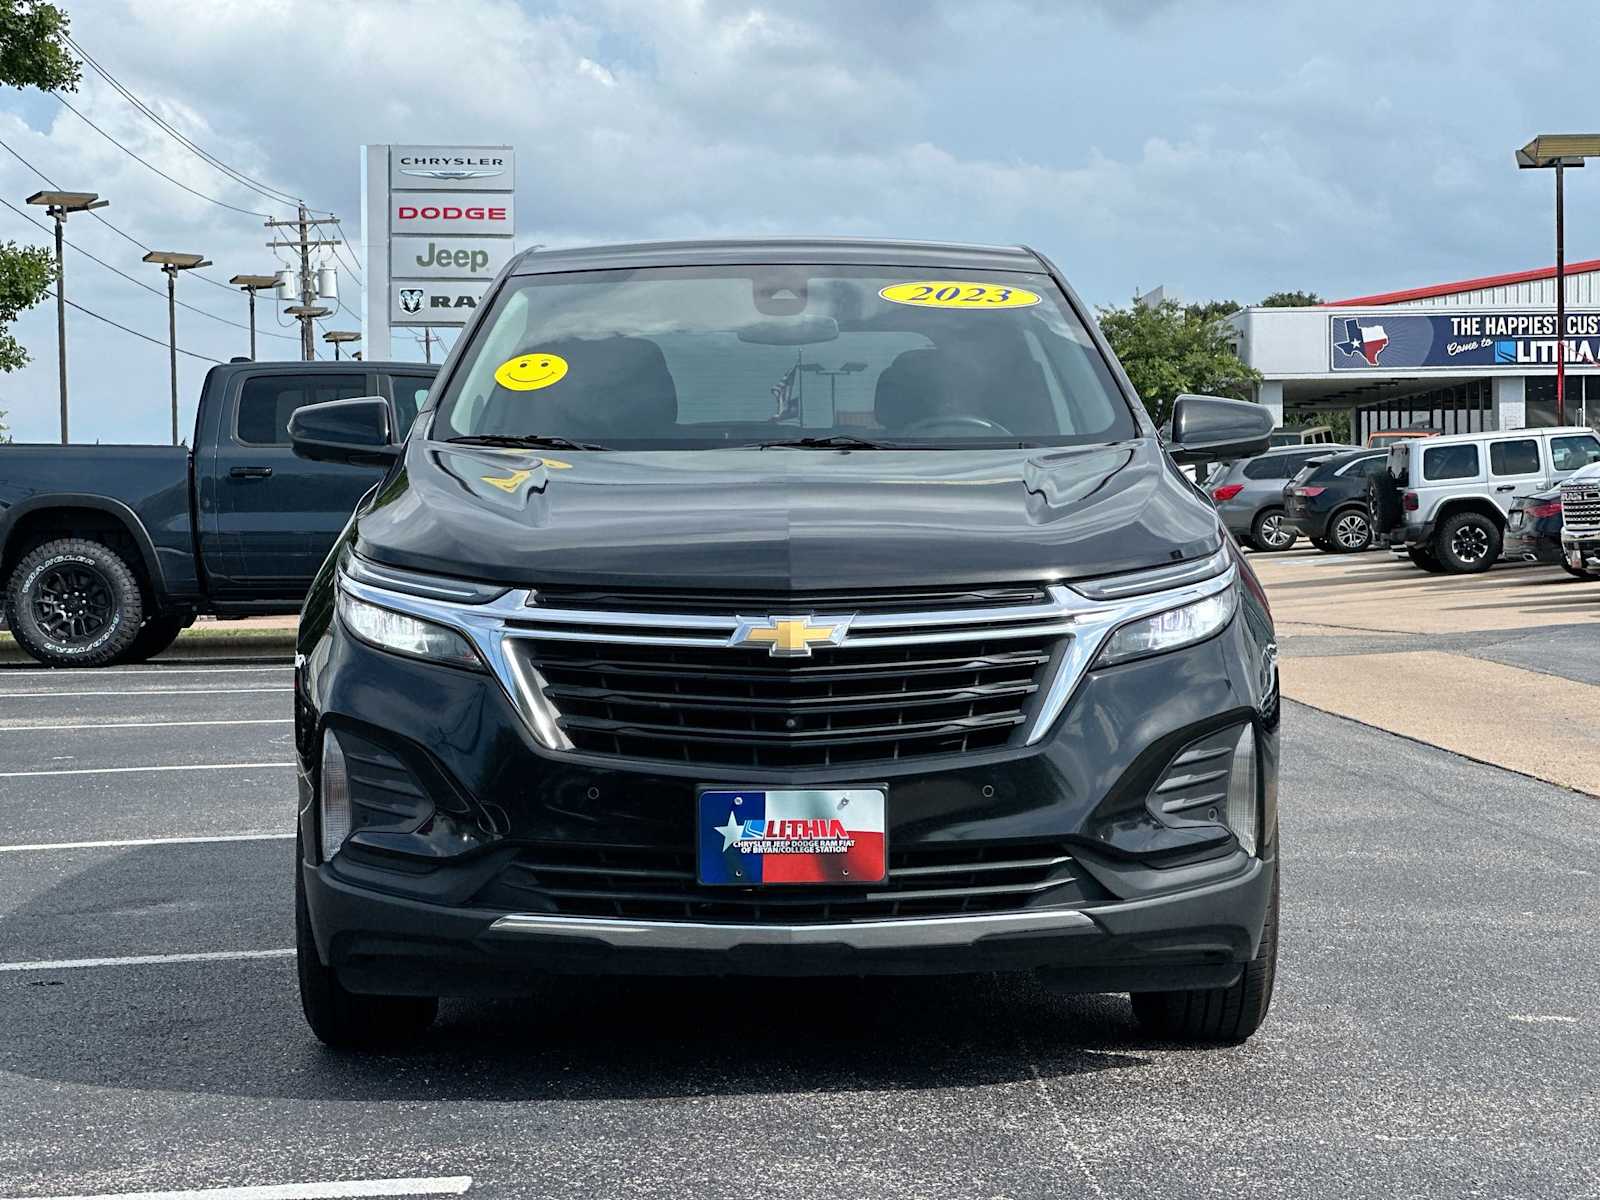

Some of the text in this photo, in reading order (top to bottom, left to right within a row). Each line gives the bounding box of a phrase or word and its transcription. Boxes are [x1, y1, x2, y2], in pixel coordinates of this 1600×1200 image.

[400, 157, 504, 166] CHRYSLER
[398, 207, 507, 220] DODGE
[416, 242, 489, 272] Jeep
[430, 295, 483, 309] RA
[909, 286, 1012, 303] 2023
[1450, 316, 1481, 336] THE
[1447, 337, 1494, 356] Come to
[1517, 339, 1595, 363] LITHIA
[22, 554, 96, 593] WRANGLER
[765, 819, 850, 838] LITHIA
